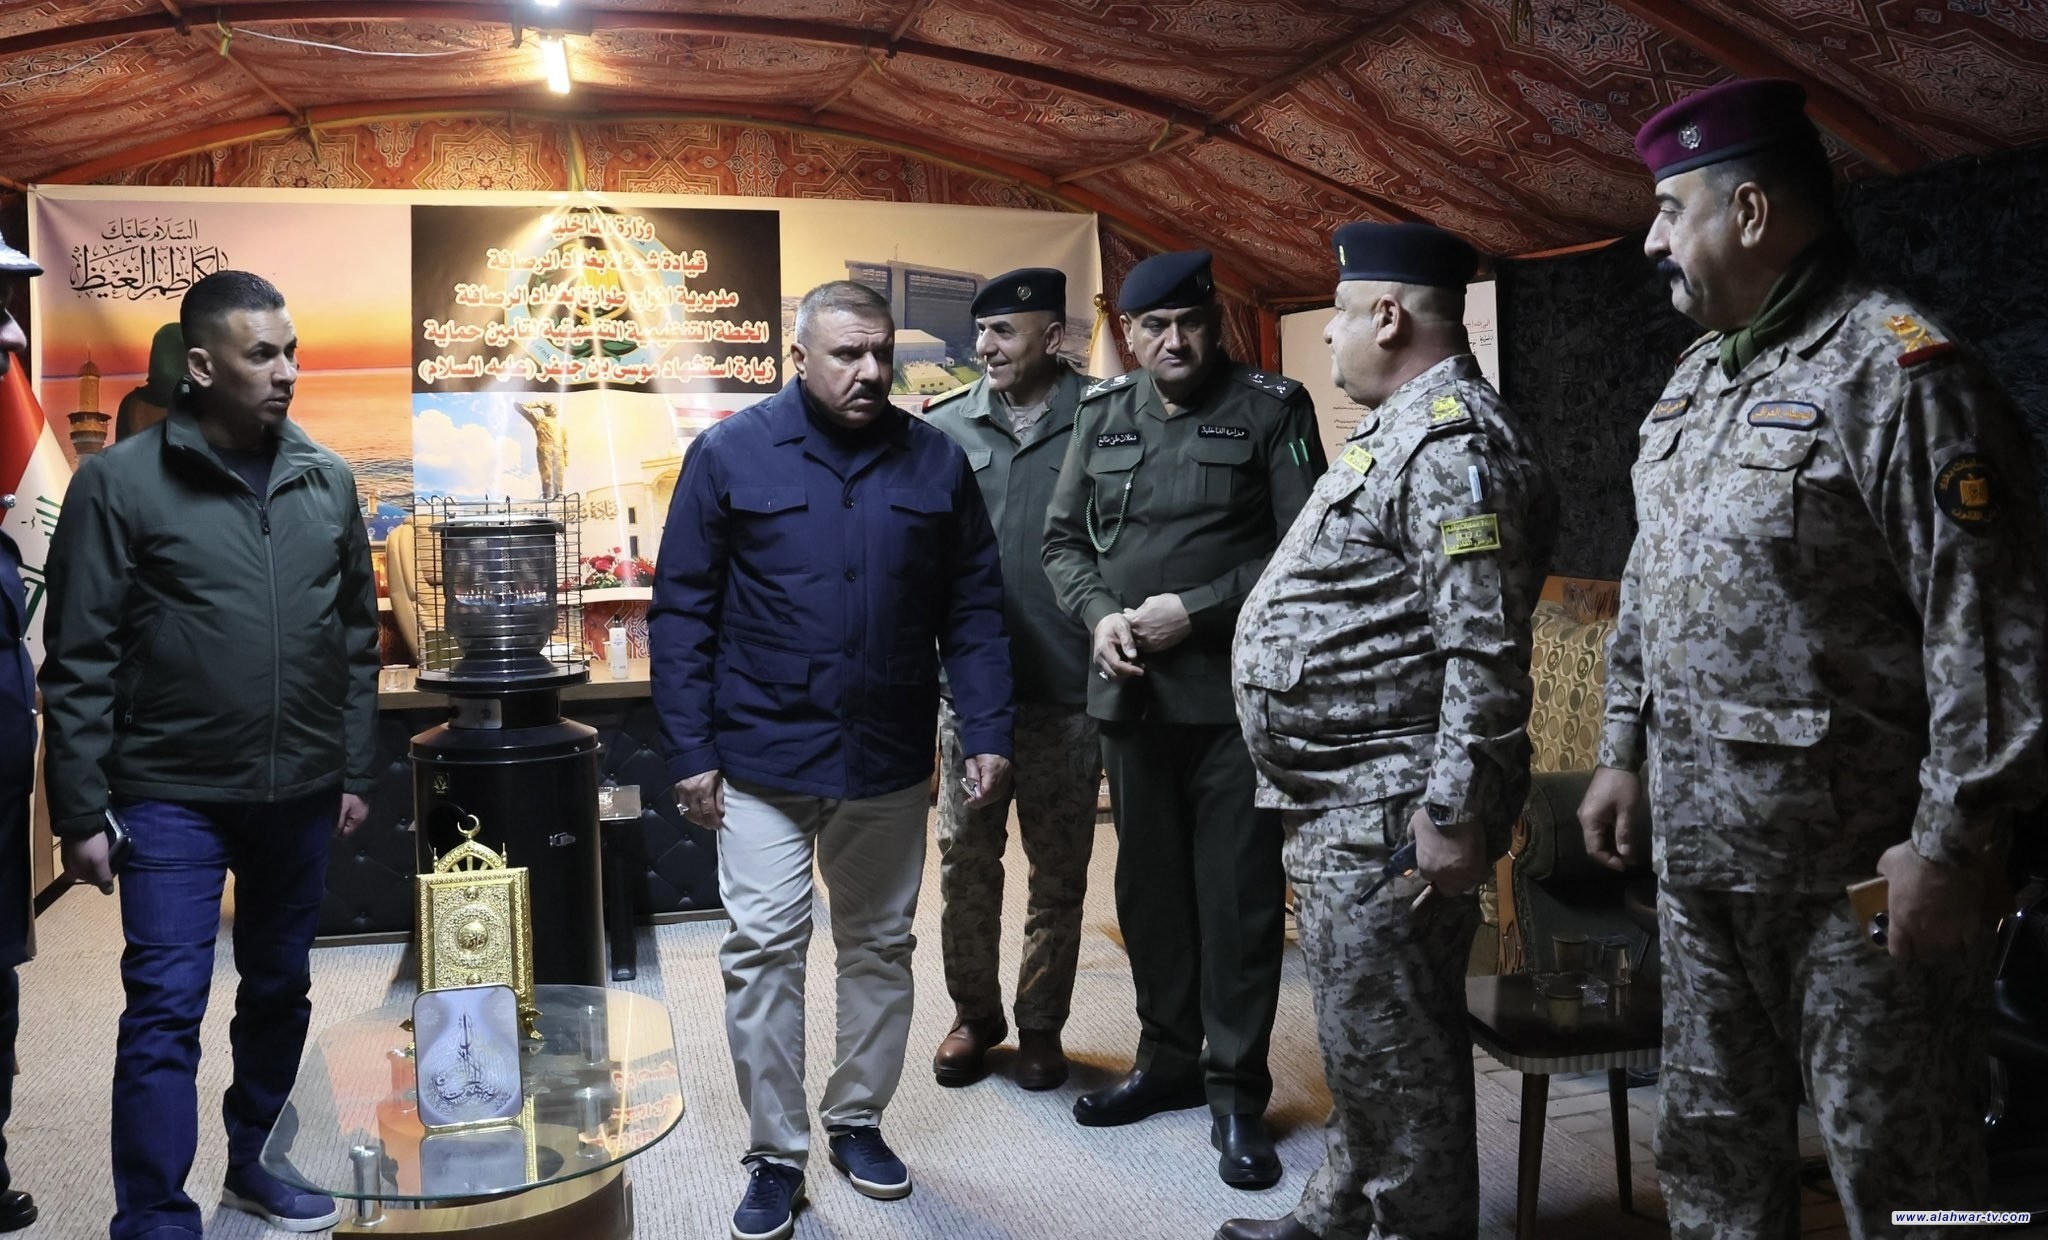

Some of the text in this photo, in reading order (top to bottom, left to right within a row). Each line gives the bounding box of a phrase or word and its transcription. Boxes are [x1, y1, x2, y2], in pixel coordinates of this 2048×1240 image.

[615, 215, 655, 241] وزارة
[486, 248, 560, 275] الرصافة
[662, 250, 708, 277] قيادة
[454, 283, 528, 309] الرصافة
[675, 285, 739, 312] مديرية
[423, 318, 484, 348] حماية
[713, 320, 770, 344] الخطة
[536, 355, 585, 382] جعفر
[586, 355, 611, 380] بن
[612, 360, 661, 383] موسى
[661, 353, 734, 383] استشهاد
[734, 355, 776, 385] زيارة
